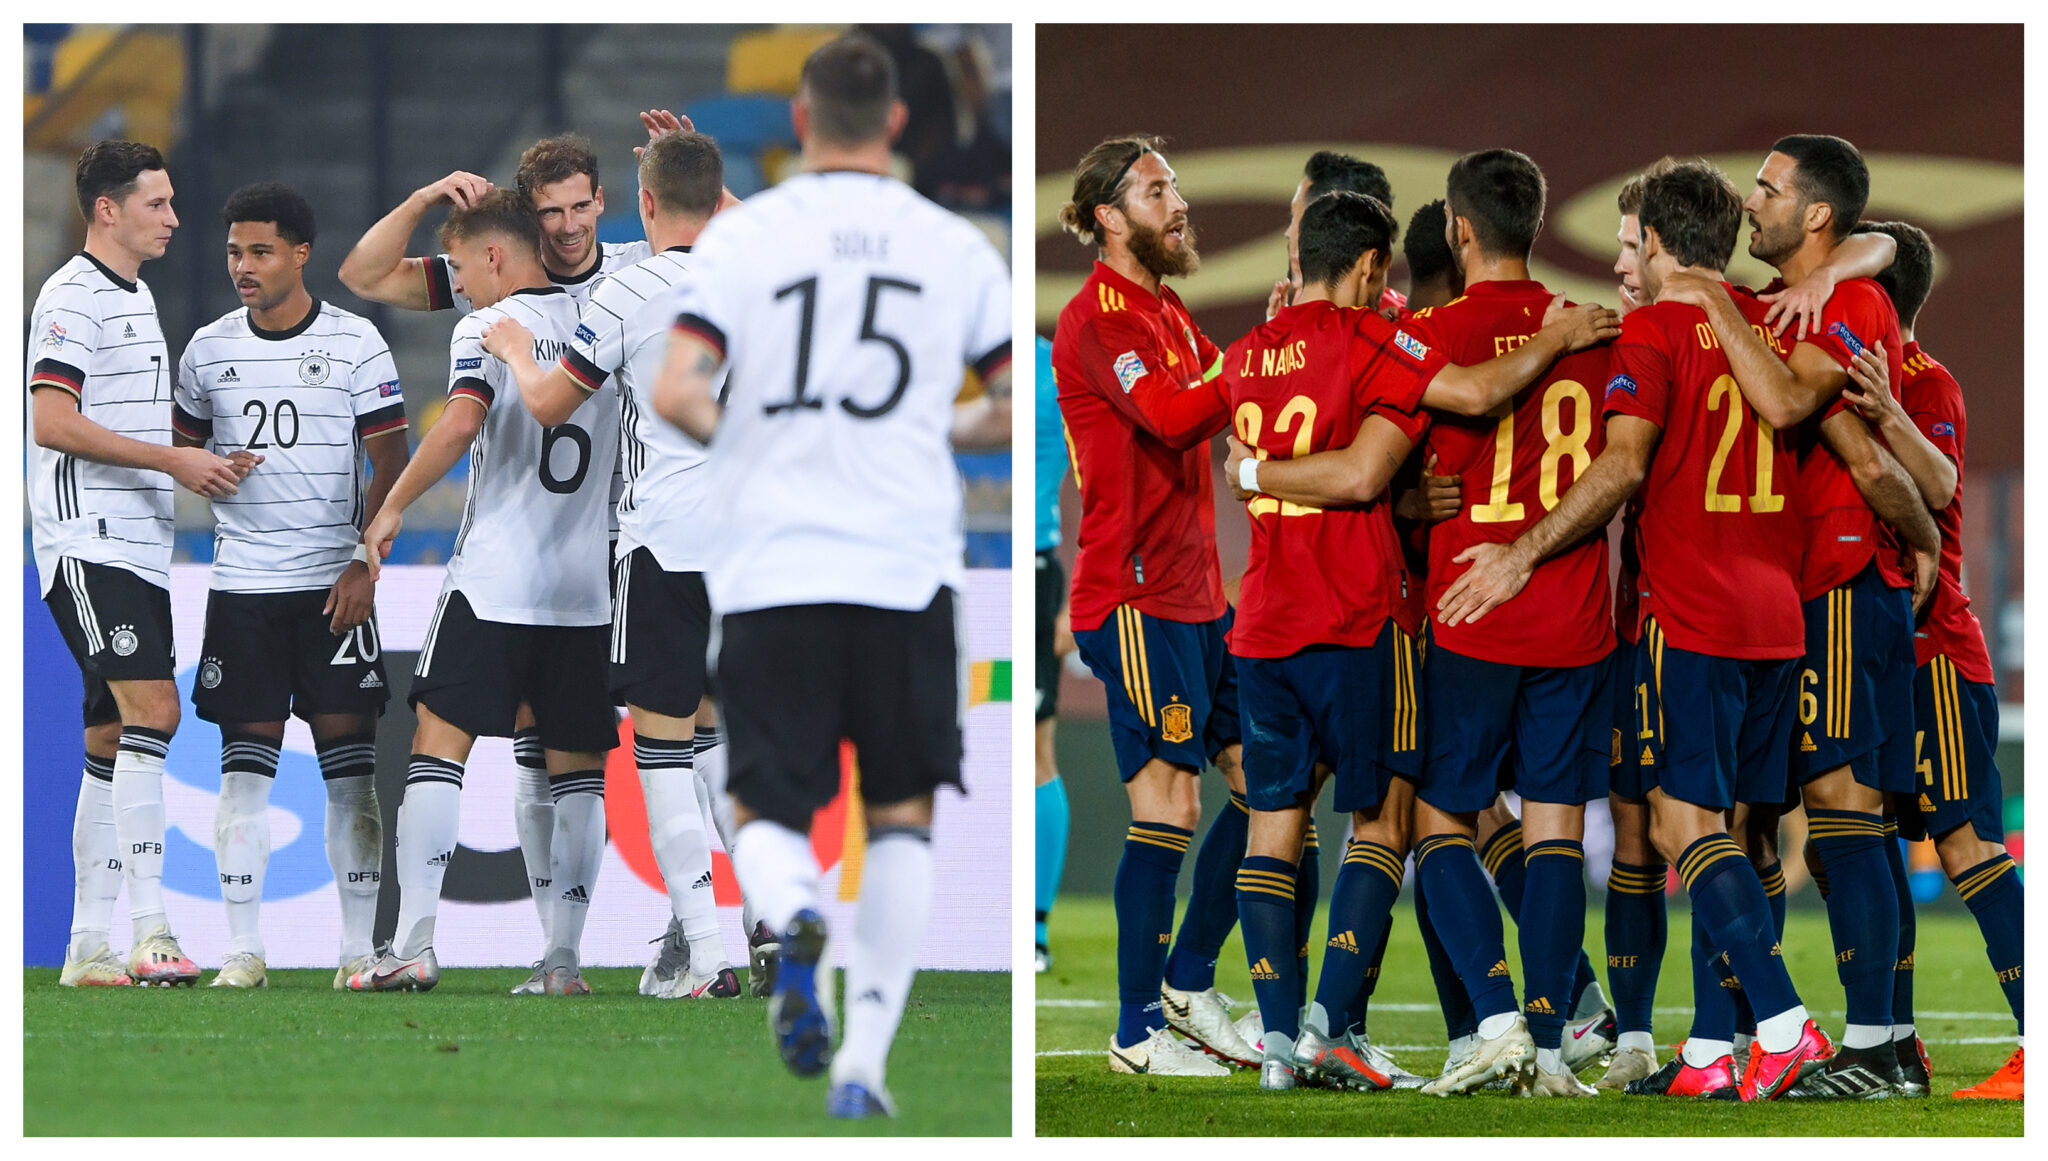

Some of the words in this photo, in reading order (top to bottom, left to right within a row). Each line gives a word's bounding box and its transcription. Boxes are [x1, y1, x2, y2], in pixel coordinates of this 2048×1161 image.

[763, 275, 923, 418] 15
[1240, 349, 1254, 377] J.
[150, 355, 161, 405] 7
[242, 399, 299, 449] 20
[1705, 374, 1785, 513] 21
[538, 423, 592, 494] 6
[1235, 395, 1323, 519] 22
[1471, 379, 1592, 523] 18
[330, 616, 379, 665] 20
[132, 841, 162, 854] DFB
[220, 873, 253, 885] DFB
[348, 871, 380, 882] DFB
[1328, 940, 1359, 954] adidas
[1608, 955, 1638, 968] RFEF
